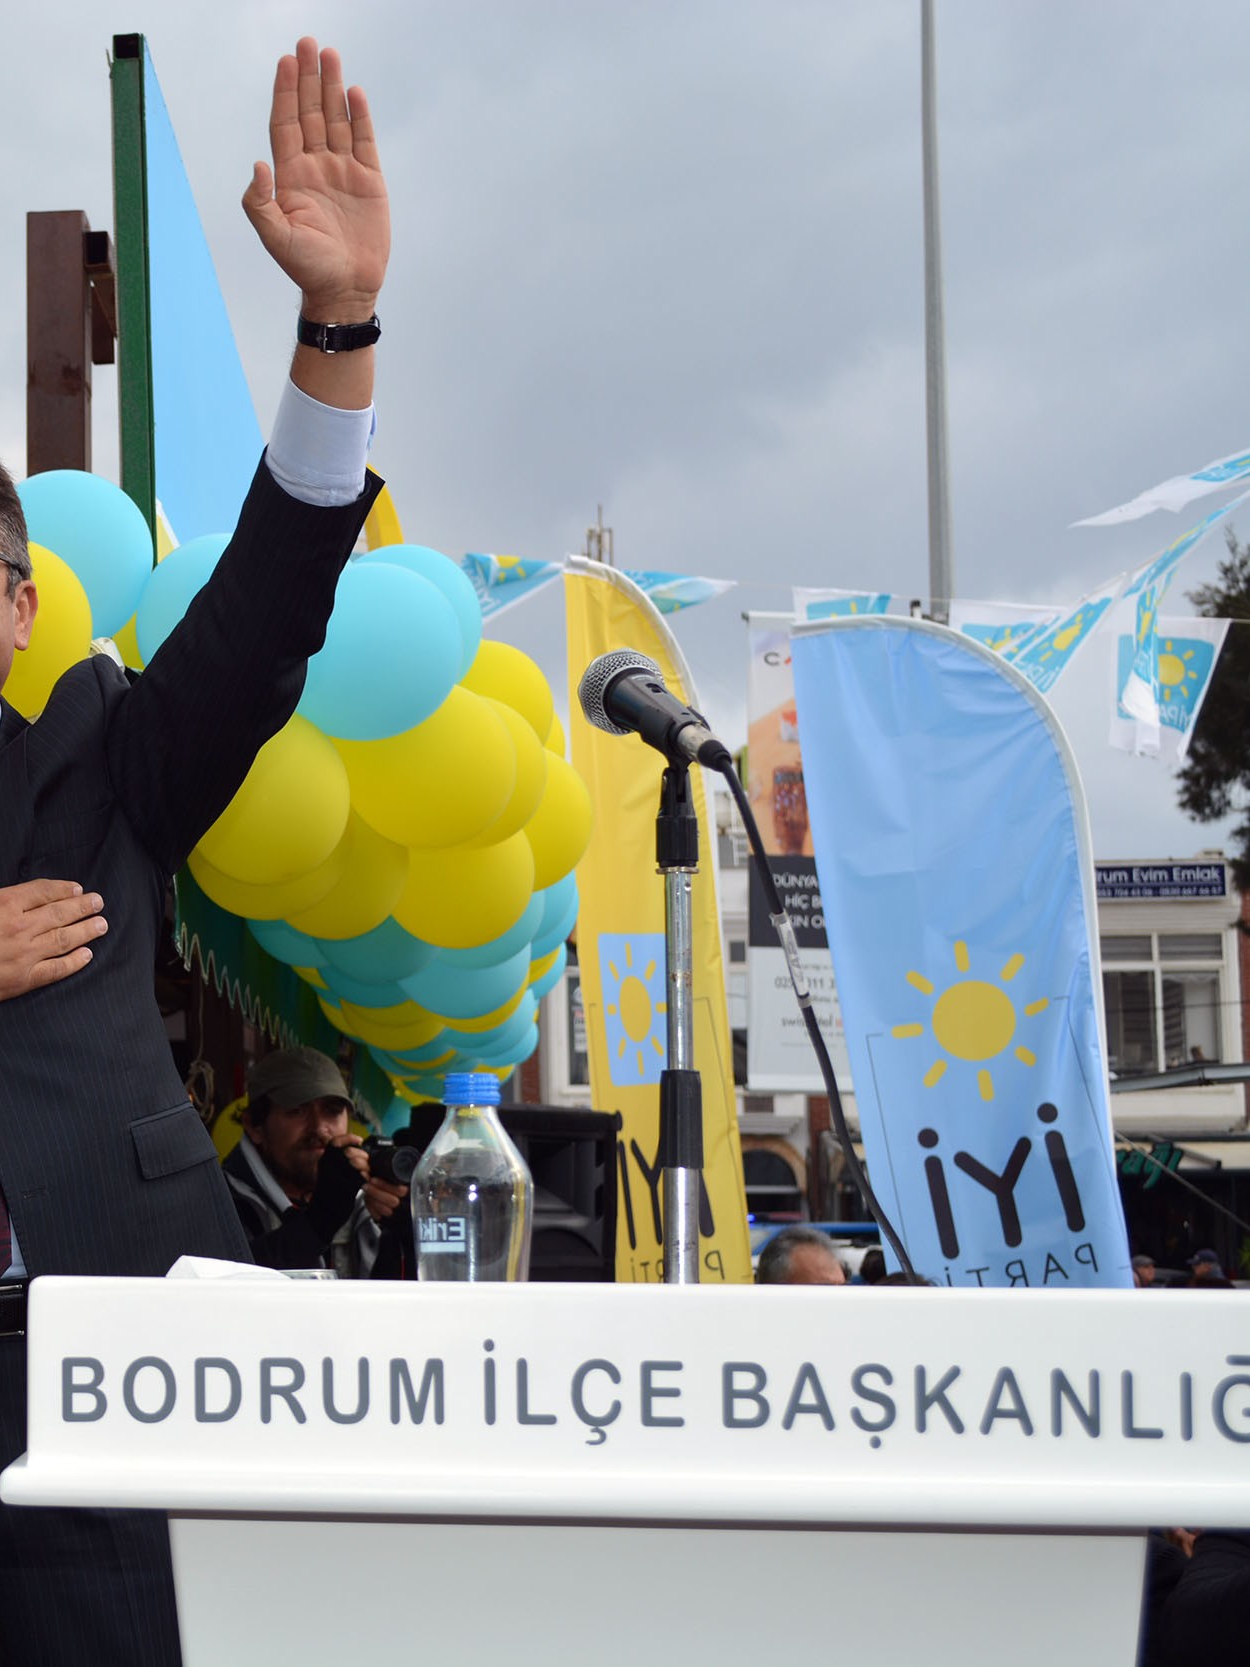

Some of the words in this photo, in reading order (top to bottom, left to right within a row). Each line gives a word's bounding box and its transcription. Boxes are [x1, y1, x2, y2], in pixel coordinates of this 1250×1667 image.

[1132, 867, 1168, 882] Evim
[1172, 866, 1220, 882] Emlak
[61, 1356, 446, 1426] BODRUM
[483, 1338, 686, 1447] İLÇE
